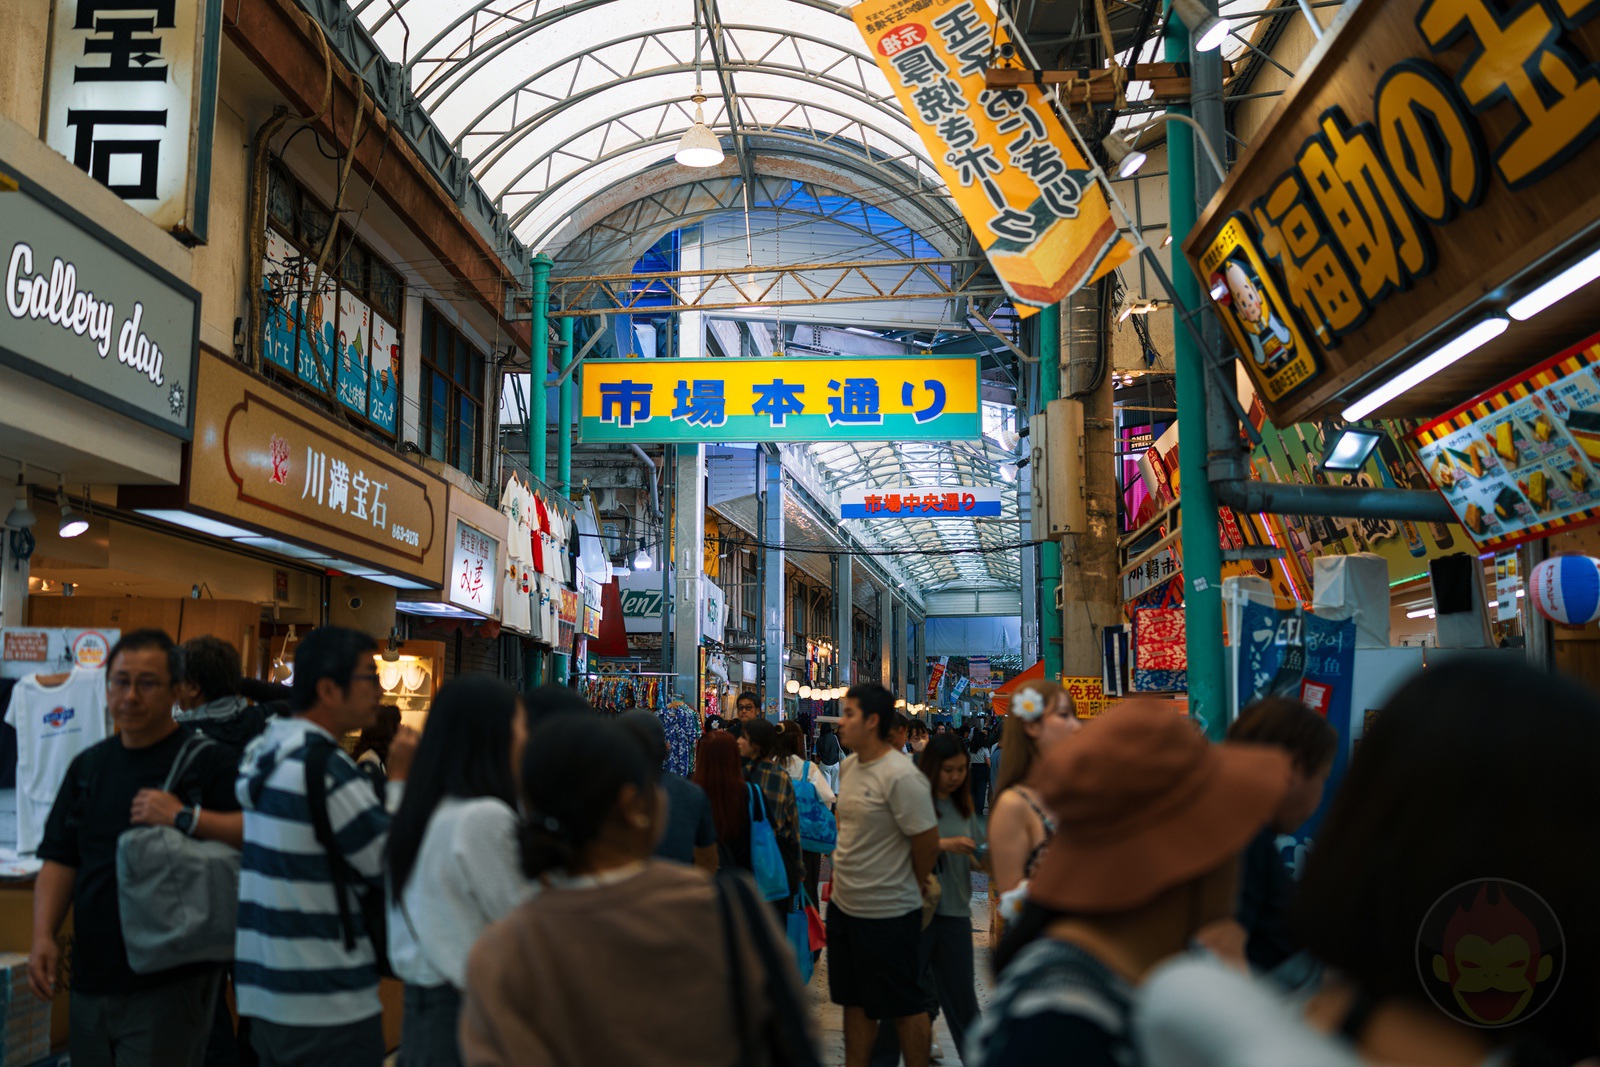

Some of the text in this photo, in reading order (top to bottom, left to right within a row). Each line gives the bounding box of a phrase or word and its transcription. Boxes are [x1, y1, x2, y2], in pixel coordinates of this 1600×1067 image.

[1250, 0, 1600, 350] 福助の玉
[5, 242, 115, 359] Gallery
[598, 378, 949, 429] 市場本通り
[300, 444, 388, 531] 川満宝石
[863, 492, 977, 515] 市場中央通り
[1274, 617, 1303, 647] EEL
[1068, 684, 1118, 701] 免税
